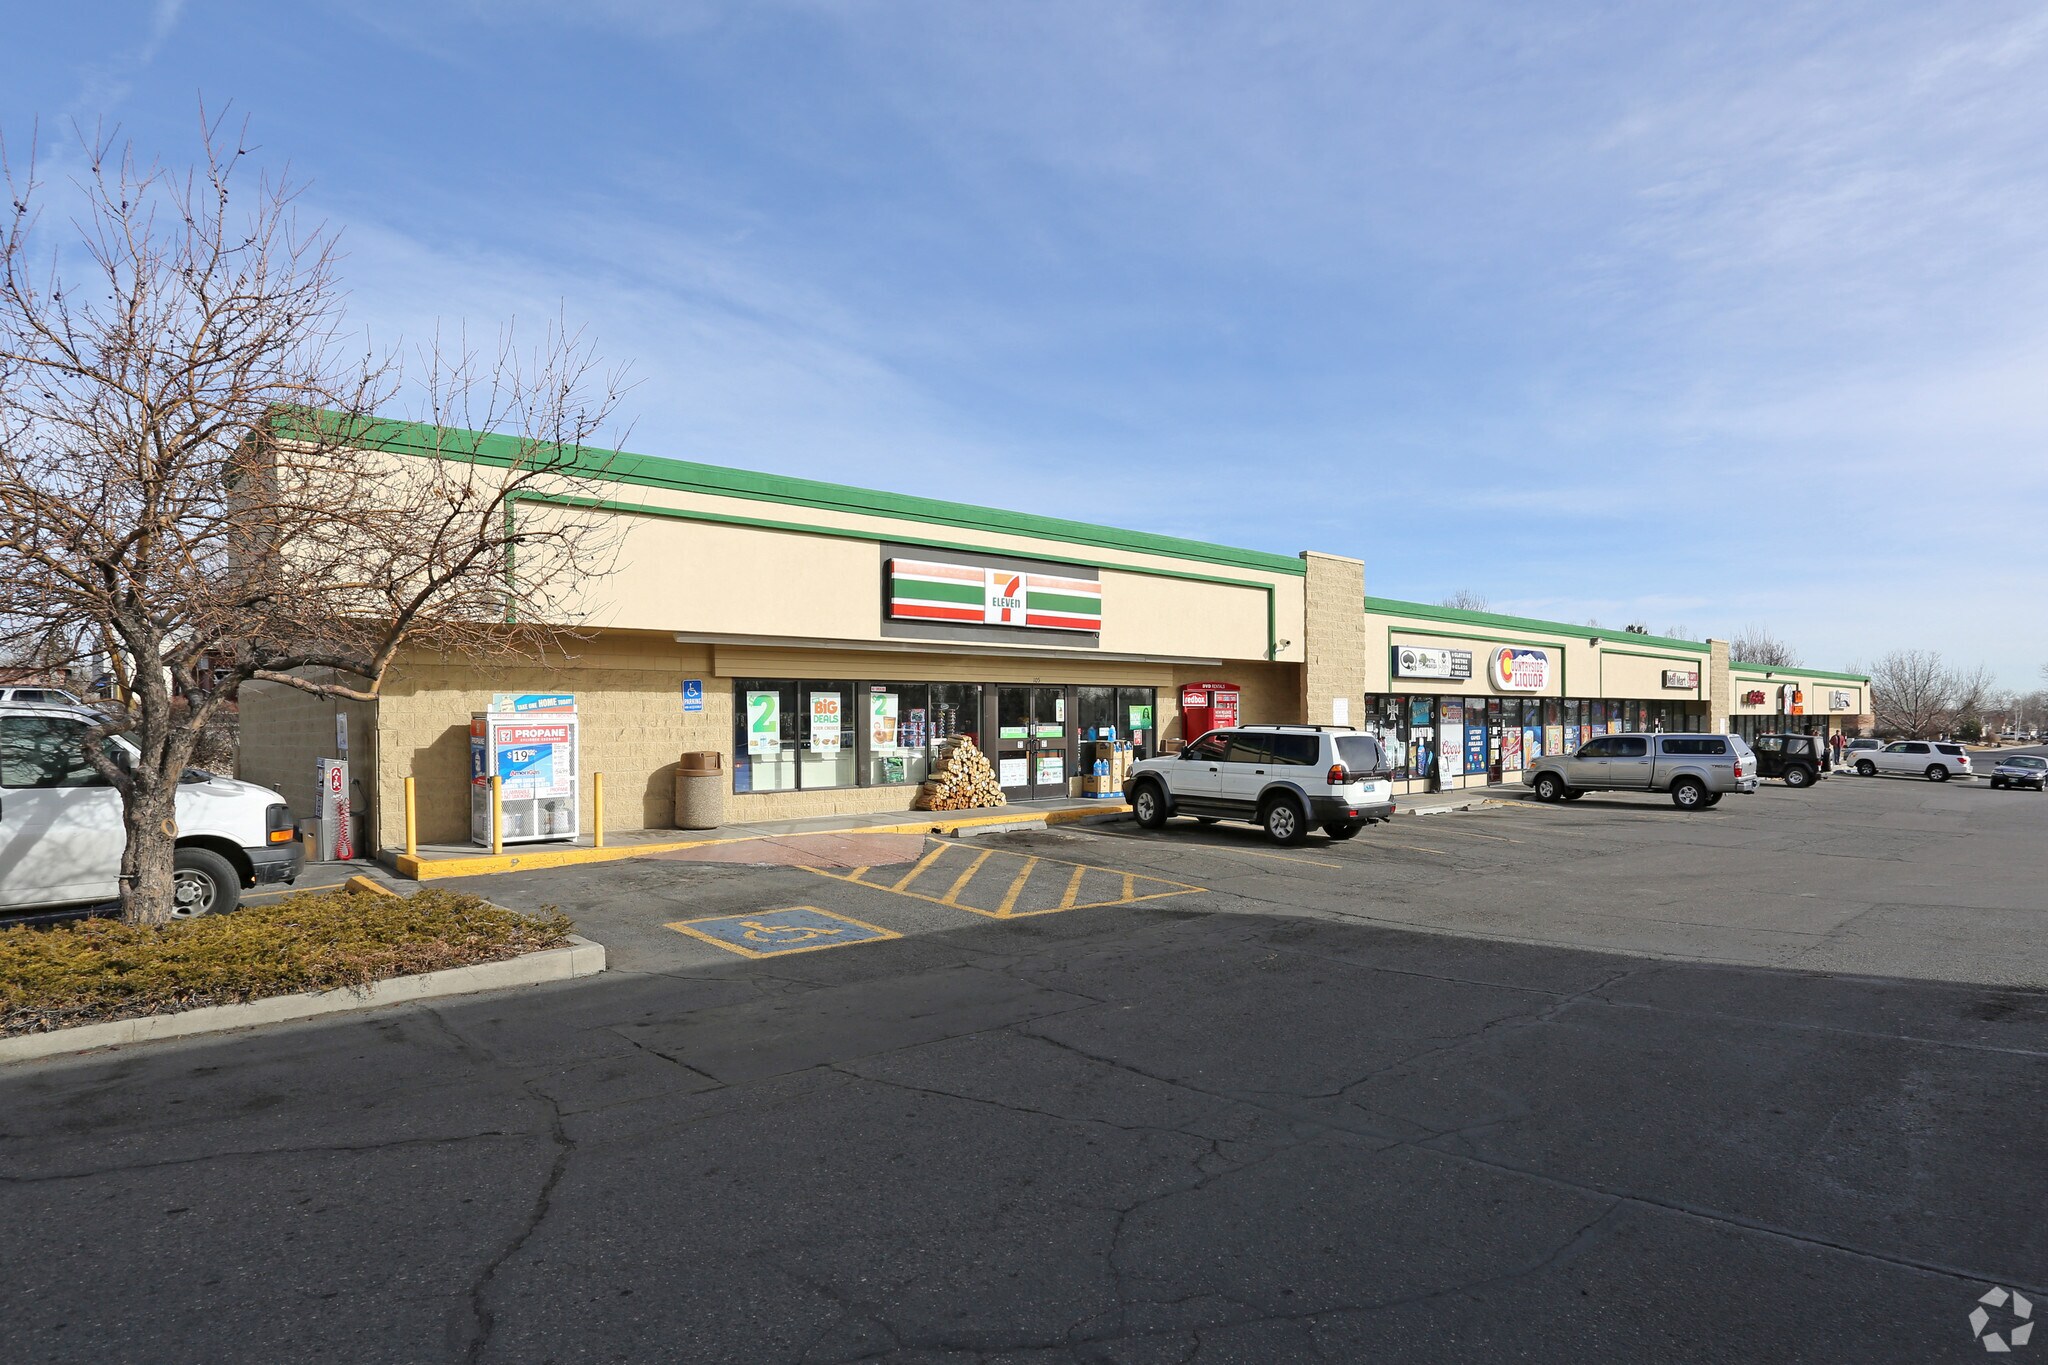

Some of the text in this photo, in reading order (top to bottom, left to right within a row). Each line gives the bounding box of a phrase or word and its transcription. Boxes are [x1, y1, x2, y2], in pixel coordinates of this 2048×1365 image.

[992, 597, 1021, 608] ELEVEN
[994, 573, 1020, 622] 7
[1515, 673, 1543, 687] LIQUOR
[538, 698, 558, 708] HOME
[1185, 695, 1206, 703] redbox
[813, 715, 839, 723] DEALS
[515, 729, 566, 738] PROPANE
[1442, 740, 1461, 755] Coors
[332, 769, 341, 789] AIR
